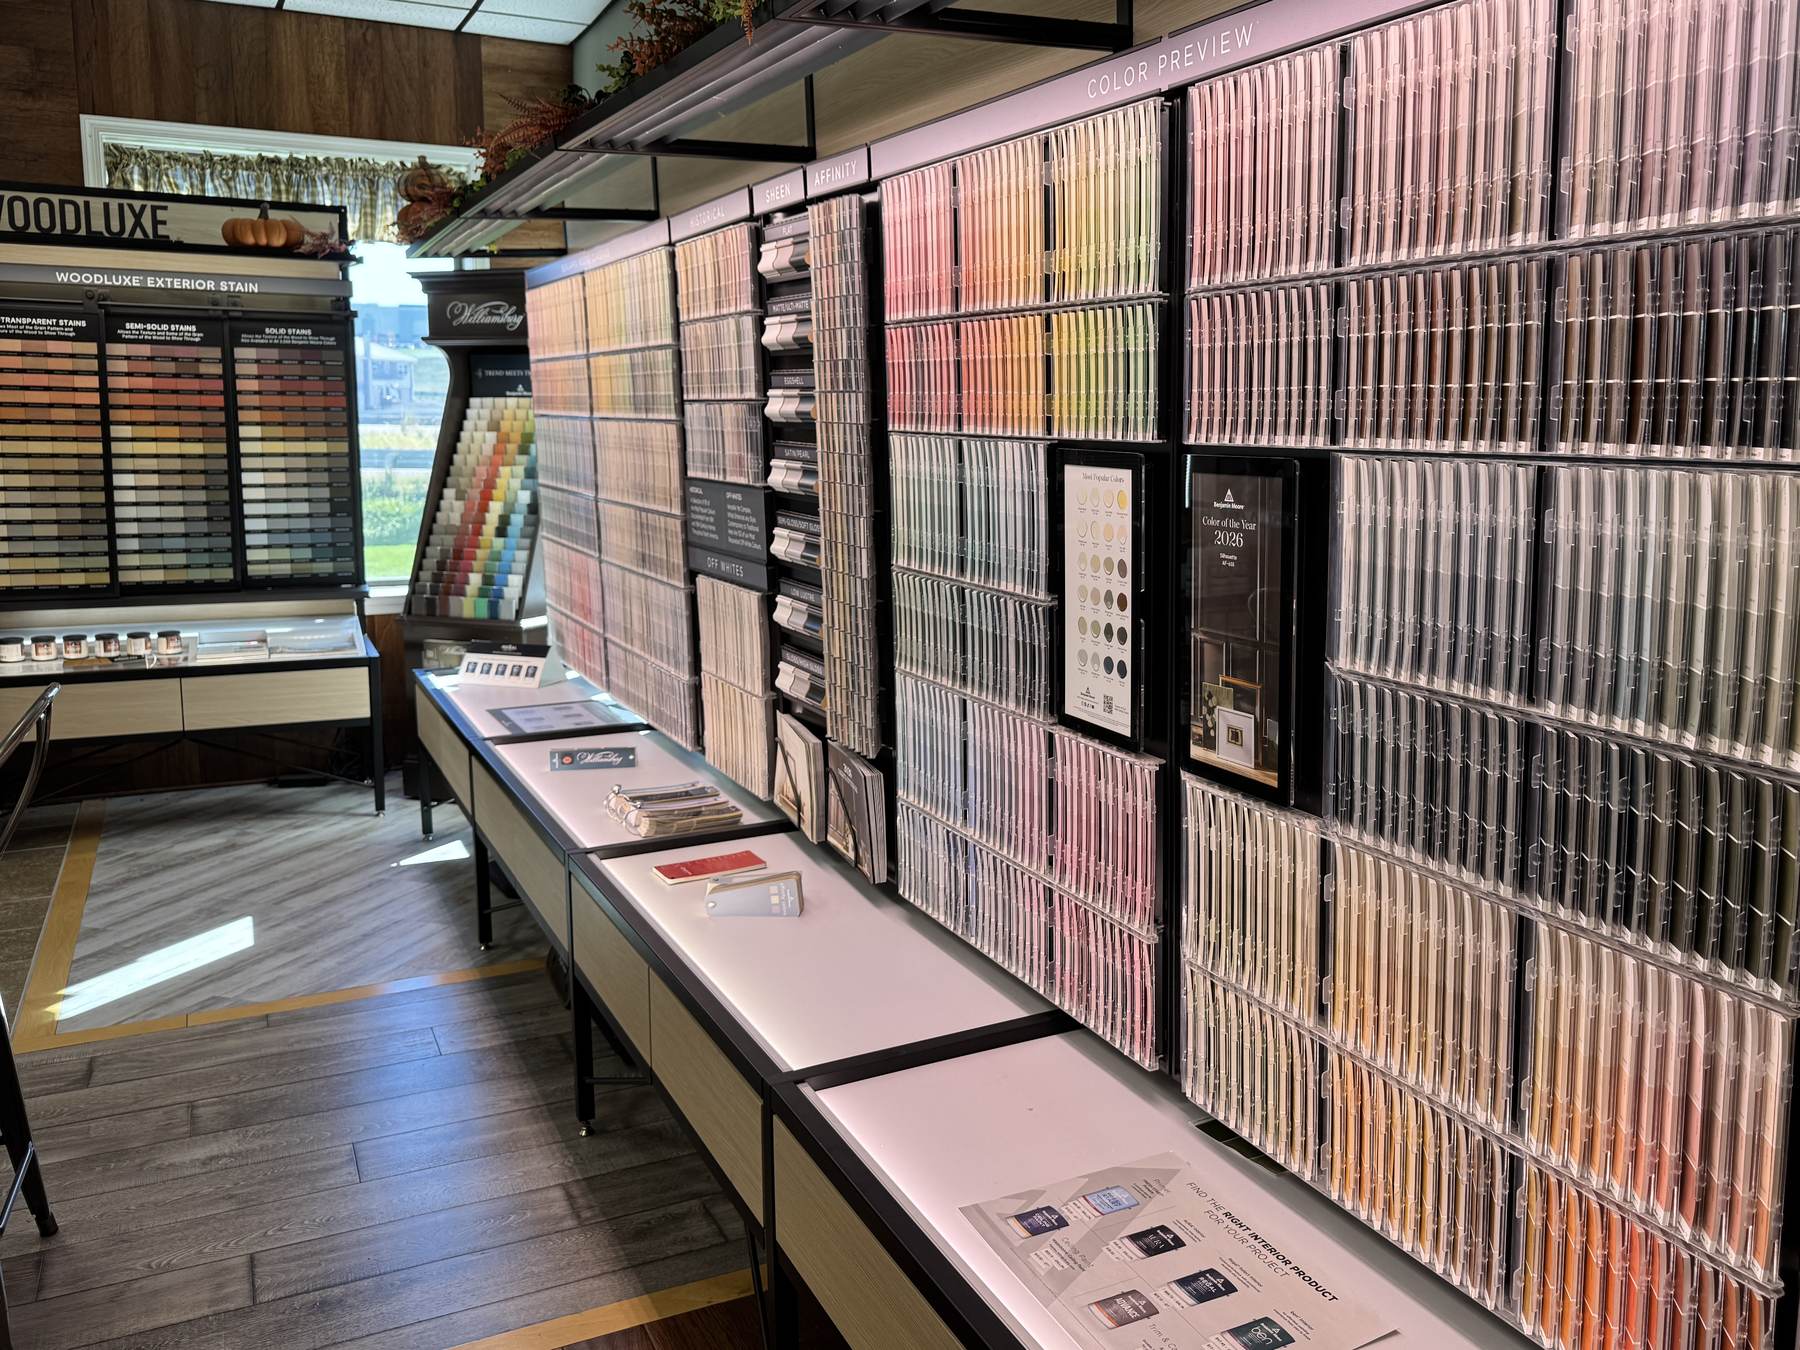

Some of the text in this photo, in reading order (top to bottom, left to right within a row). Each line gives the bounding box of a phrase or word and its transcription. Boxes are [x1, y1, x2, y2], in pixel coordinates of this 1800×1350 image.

[1088, 23, 1253, 98] COLOR PREVIEW
[814, 160, 857, 186] AFFINITY
[766, 184, 791, 204] SHEEN
[0, 195, 170, 240] OODLUXE
[147, 277, 216, 291] EXTERIOR
[220, 280, 258, 294] STAIN
[0, 316, 56, 326] TRANSPARENT
[447, 301, 525, 332] Williamsburg
[1202, 516, 1256, 530] Color of the Year
[1214, 530, 1244, 548] 2026
[707, 557, 744, 577] OFF WHITES
[1186, 1182, 1208, 1198] FIND
[1207, 1198, 1226, 1212] THE
[1222, 1211, 1251, 1232] RIGHT
[1248, 1232, 1292, 1266] INTERIOR
[1290, 1266, 1338, 1302] PRODUCT
[1203, 1210, 1224, 1225] FOR
[1224, 1224, 1249, 1245] YOUR
[1247, 1244, 1290, 1278] PROJECT
[1116, 1297, 1140, 1319] ADVANCE
[1149, 1323, 1162, 1337] Trim
[1251, 1326, 1273, 1345] ben
